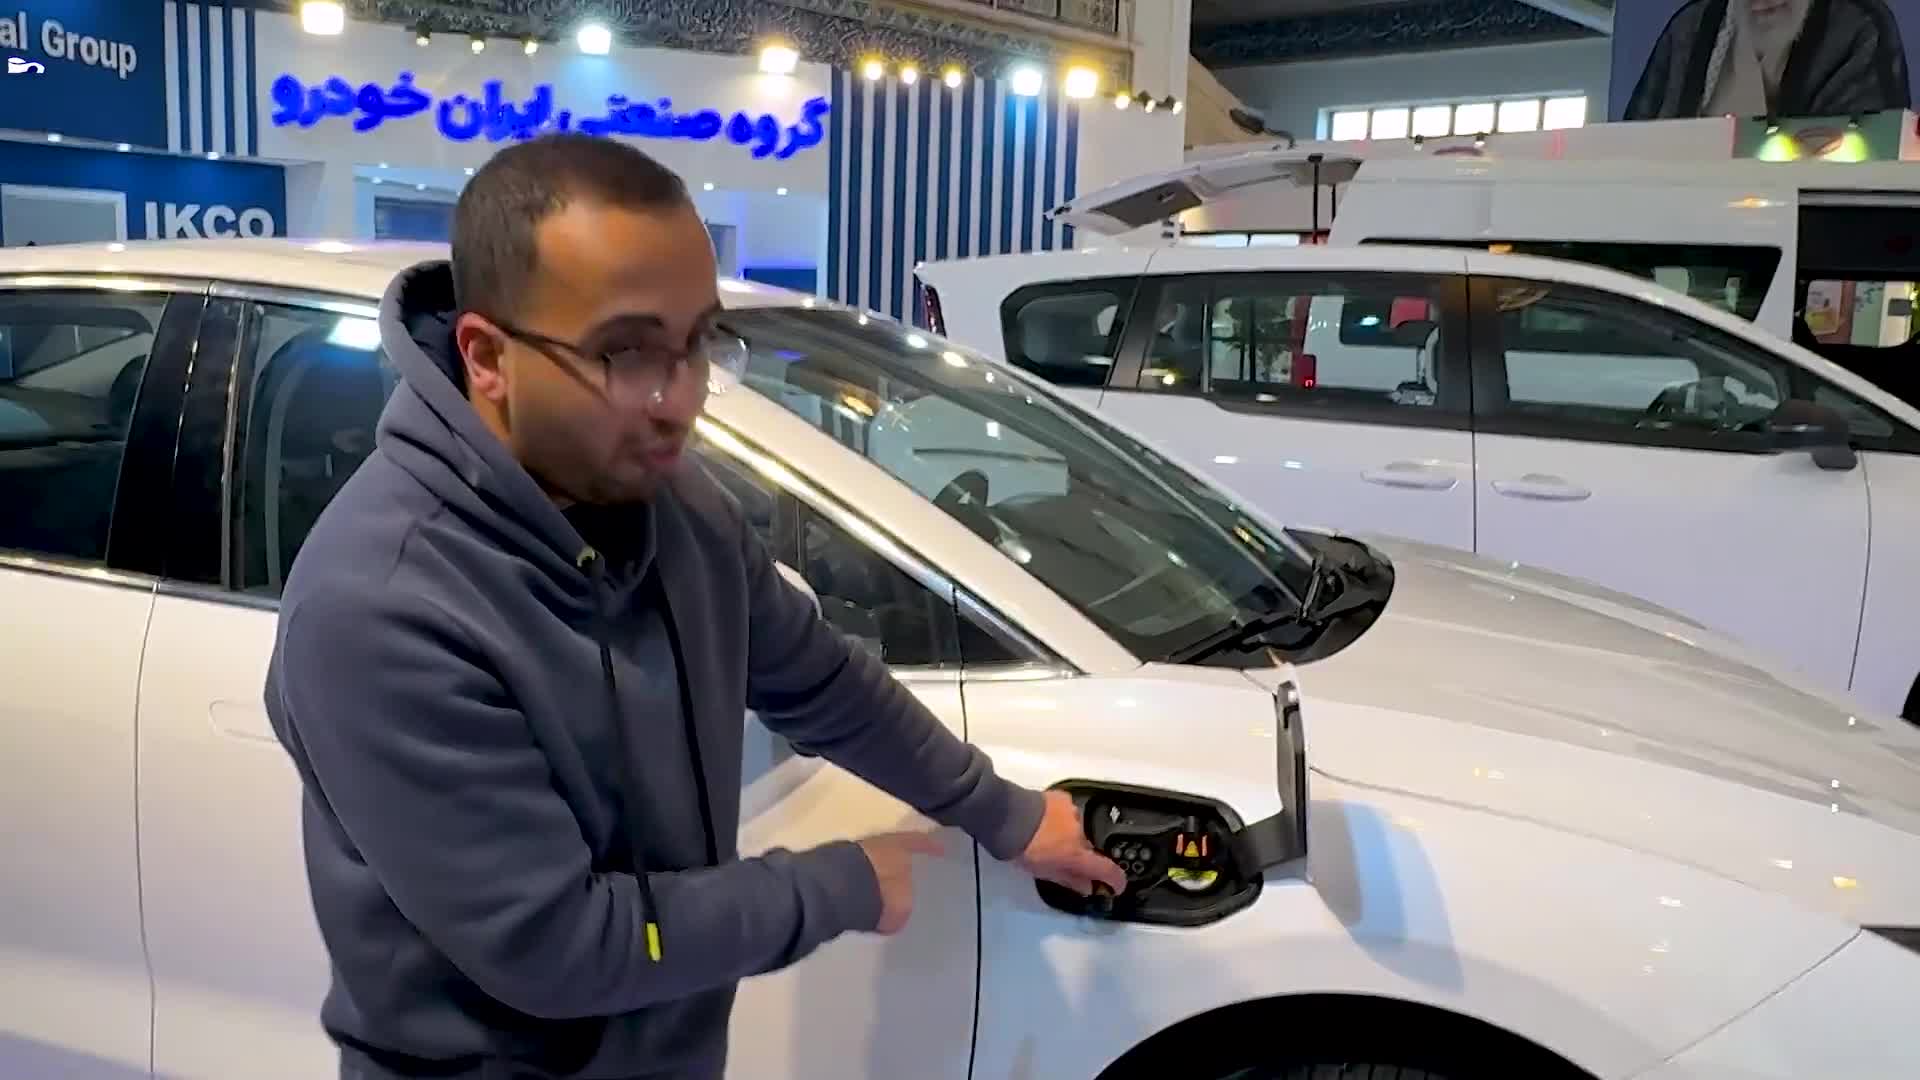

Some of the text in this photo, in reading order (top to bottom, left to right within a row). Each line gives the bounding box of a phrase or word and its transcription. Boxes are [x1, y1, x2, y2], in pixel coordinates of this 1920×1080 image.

[41, 19, 138, 80] Group
[271, 71, 432, 134] خودرو
[436, 79, 554, 143] ایران
[724, 95, 833, 161] گروه
[144, 200, 275, 240] IKCO
